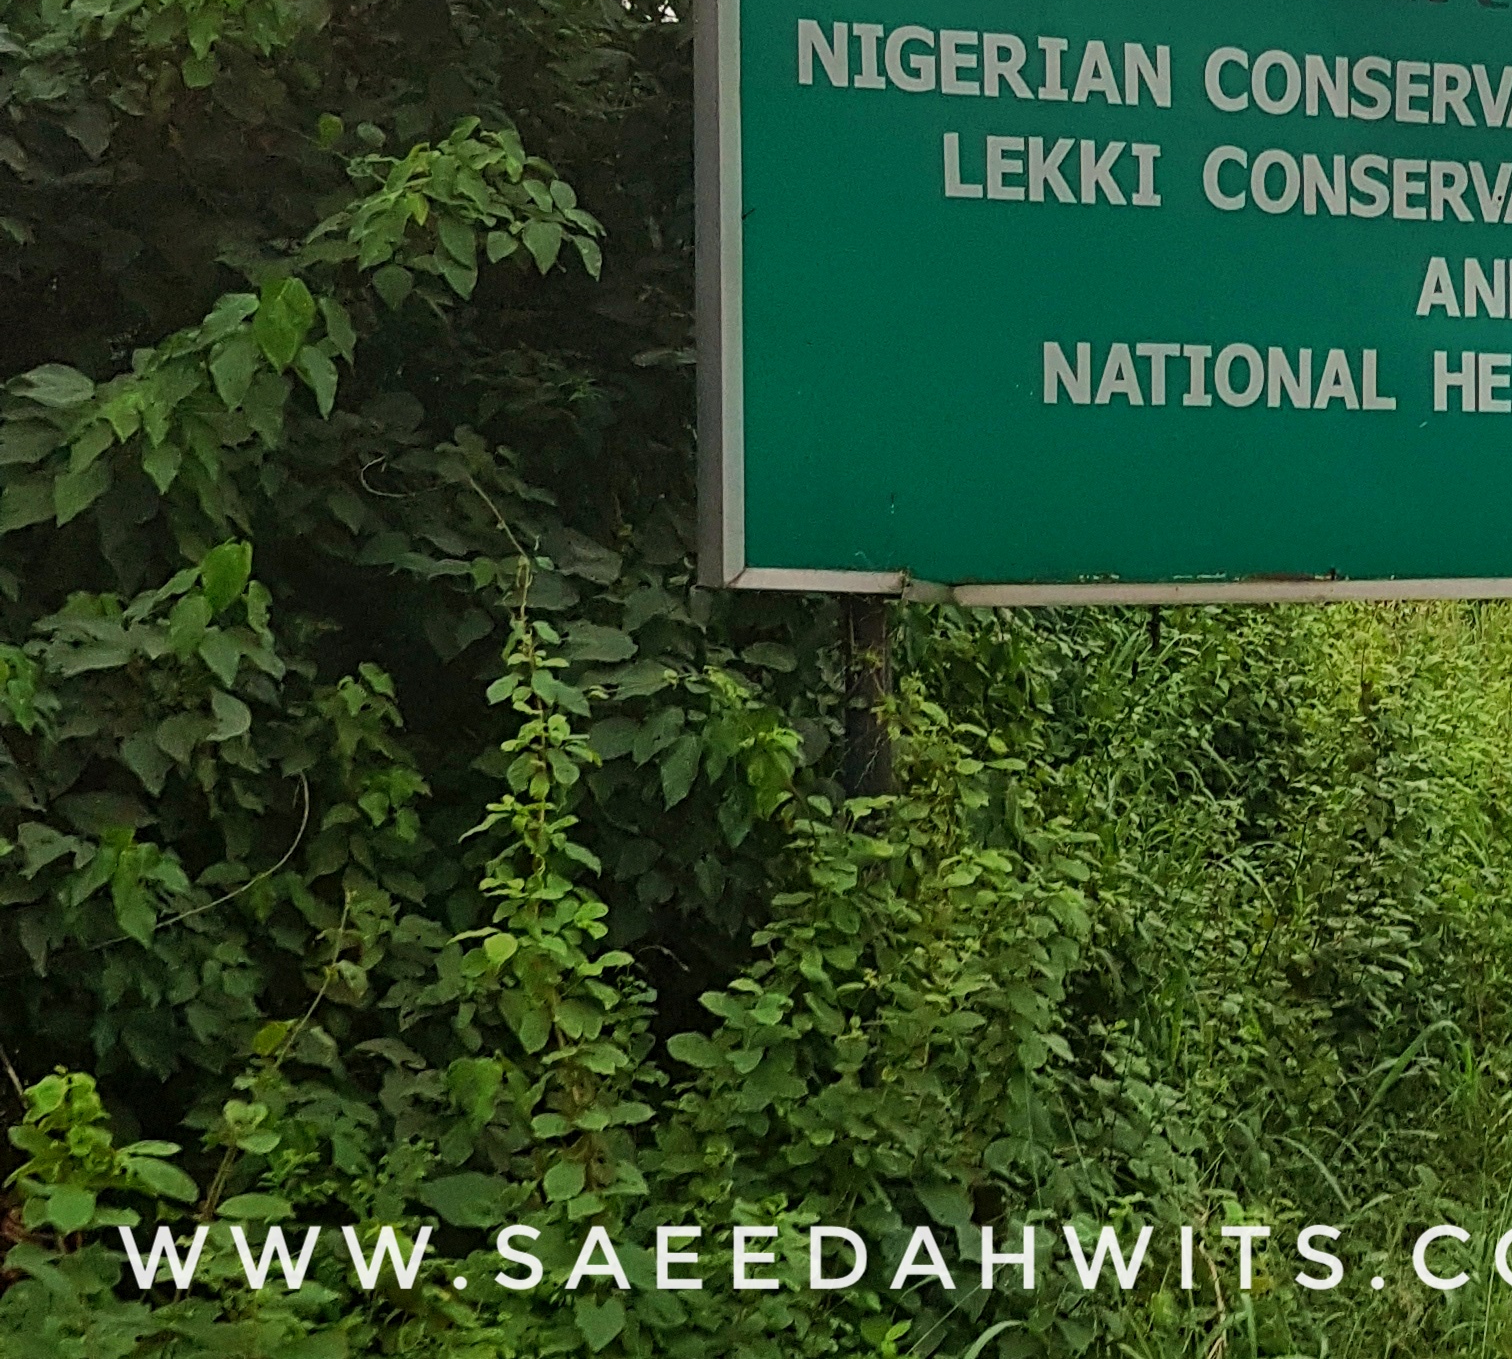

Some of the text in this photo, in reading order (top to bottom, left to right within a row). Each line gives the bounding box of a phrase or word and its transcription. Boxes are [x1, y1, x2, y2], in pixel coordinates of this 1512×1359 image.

[797, 18, 1172, 108] NIGERIAN
[943, 132, 1161, 207] LEKKI
[1043, 341, 1397, 410] NATIONAL
